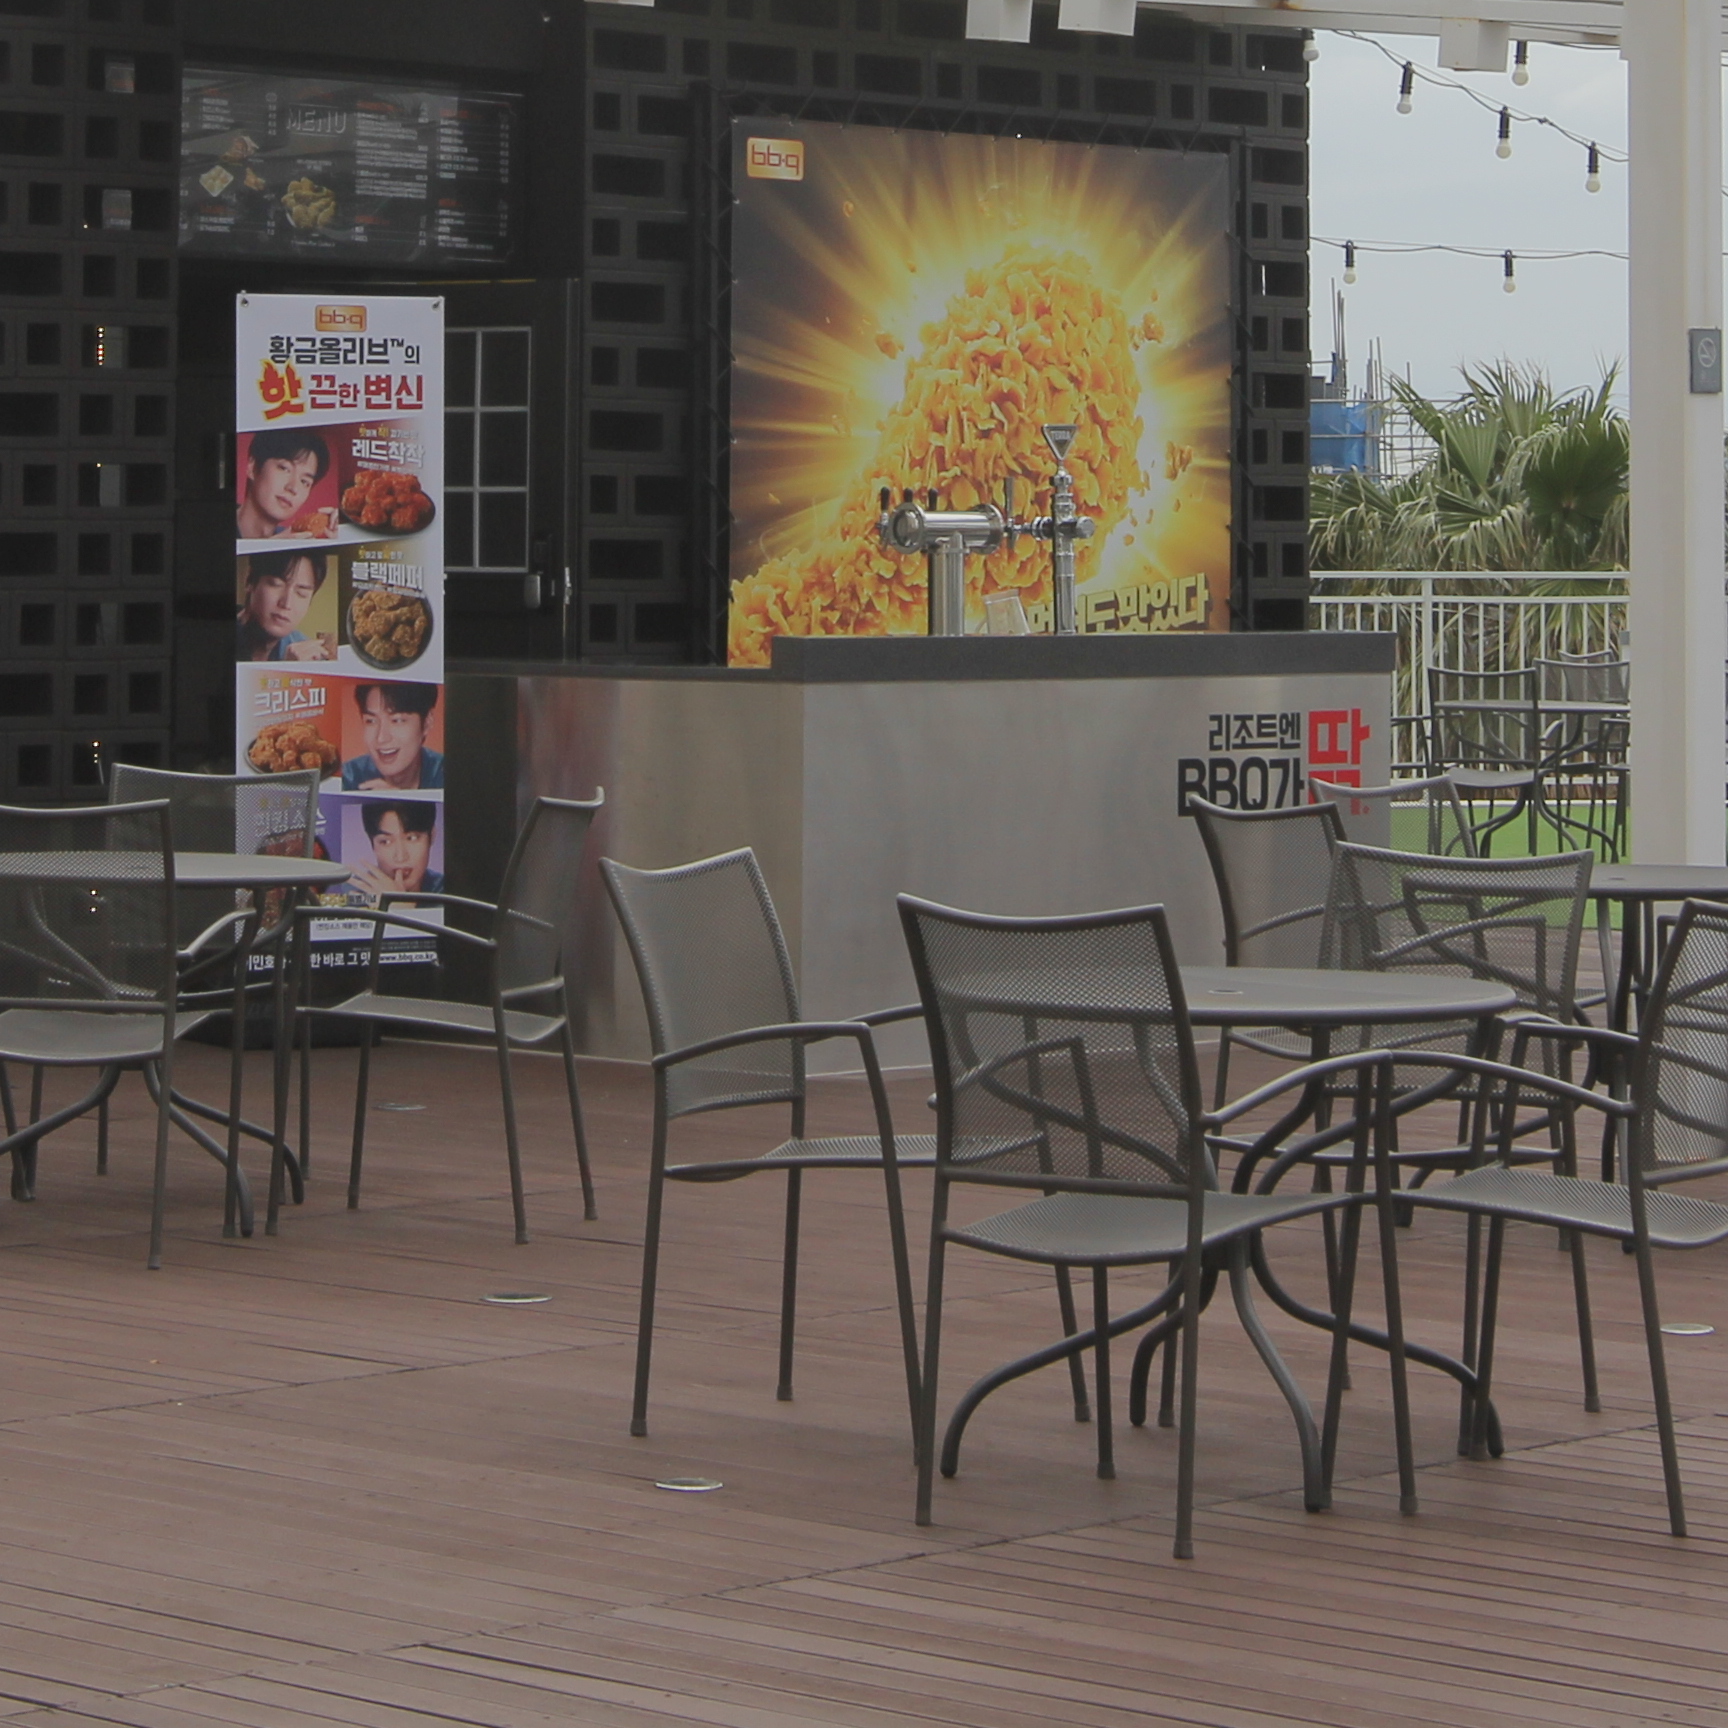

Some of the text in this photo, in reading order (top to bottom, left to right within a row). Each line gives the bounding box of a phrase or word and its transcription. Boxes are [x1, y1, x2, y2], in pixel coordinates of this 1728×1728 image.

[364, 375, 423, 410] 변신
[352, 439, 425, 470] 레드착착
[352, 561, 423, 592] 블랙페퍼
[253, 687, 326, 718] 크리스피
[1209, 711, 1301, 752] 리조트엔
[1177, 756, 1305, 817] BBQ가
[323, 952, 345, 967] 바로
[347, 952, 358, 965] 그
